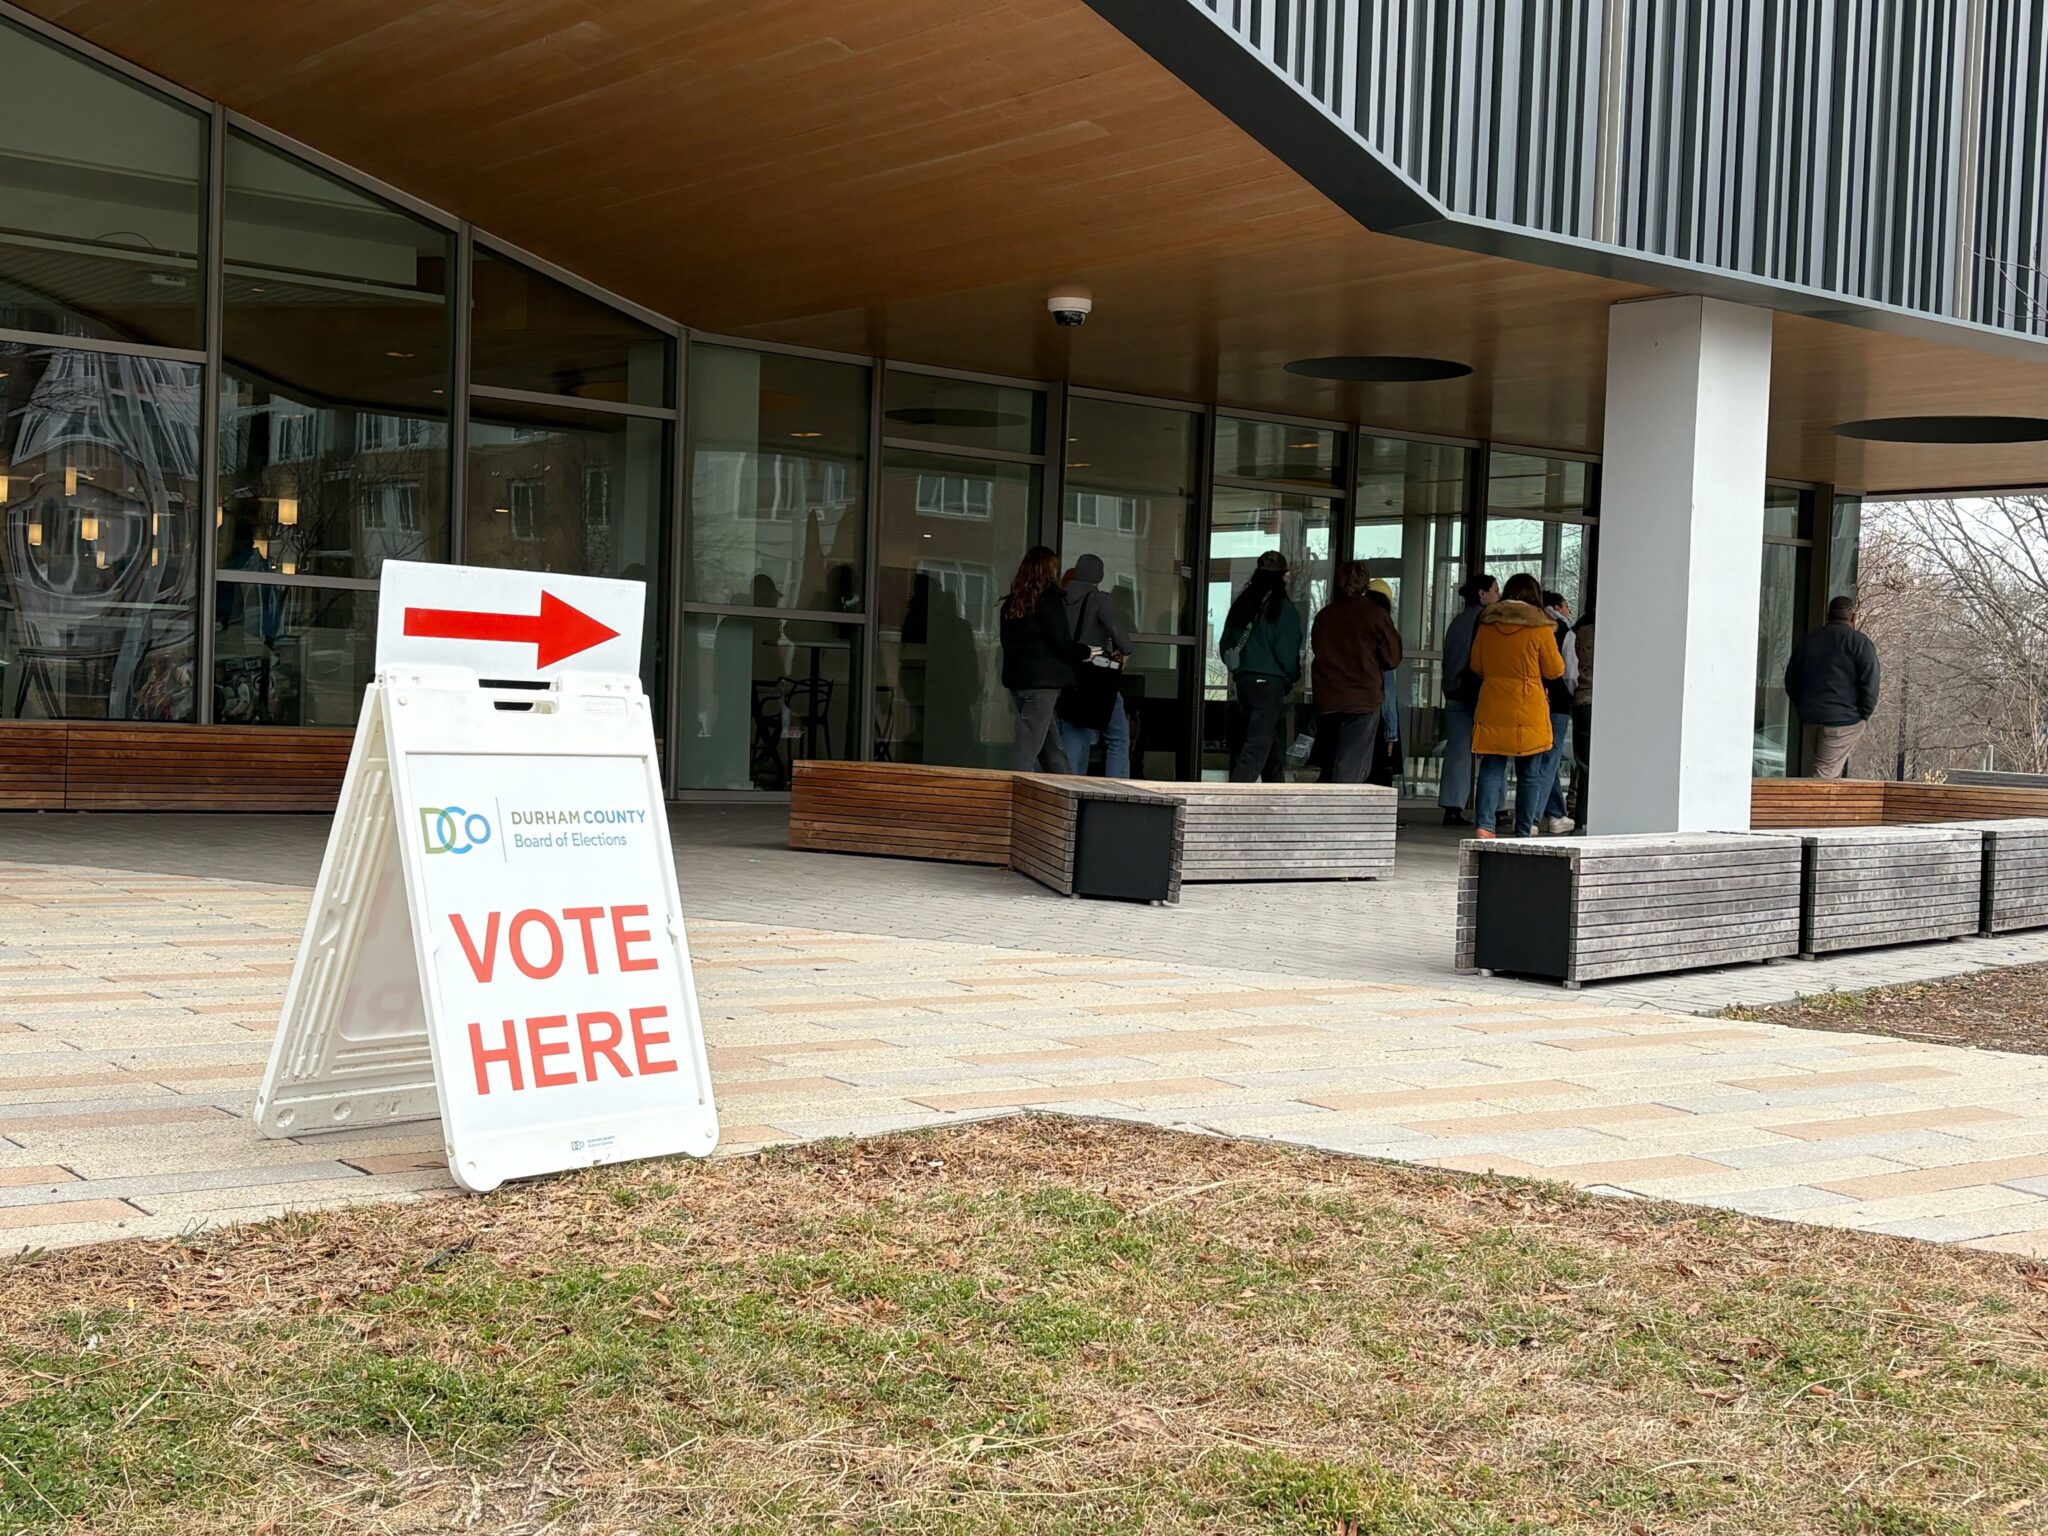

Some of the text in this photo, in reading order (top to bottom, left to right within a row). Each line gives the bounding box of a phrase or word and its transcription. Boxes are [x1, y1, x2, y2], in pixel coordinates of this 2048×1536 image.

[511, 810, 645, 825] DURHAM COUNTY
[514, 832, 627, 848] Board of Elections
[448, 904, 658, 983] VOTE
[468, 1006, 677, 1095] HERE
